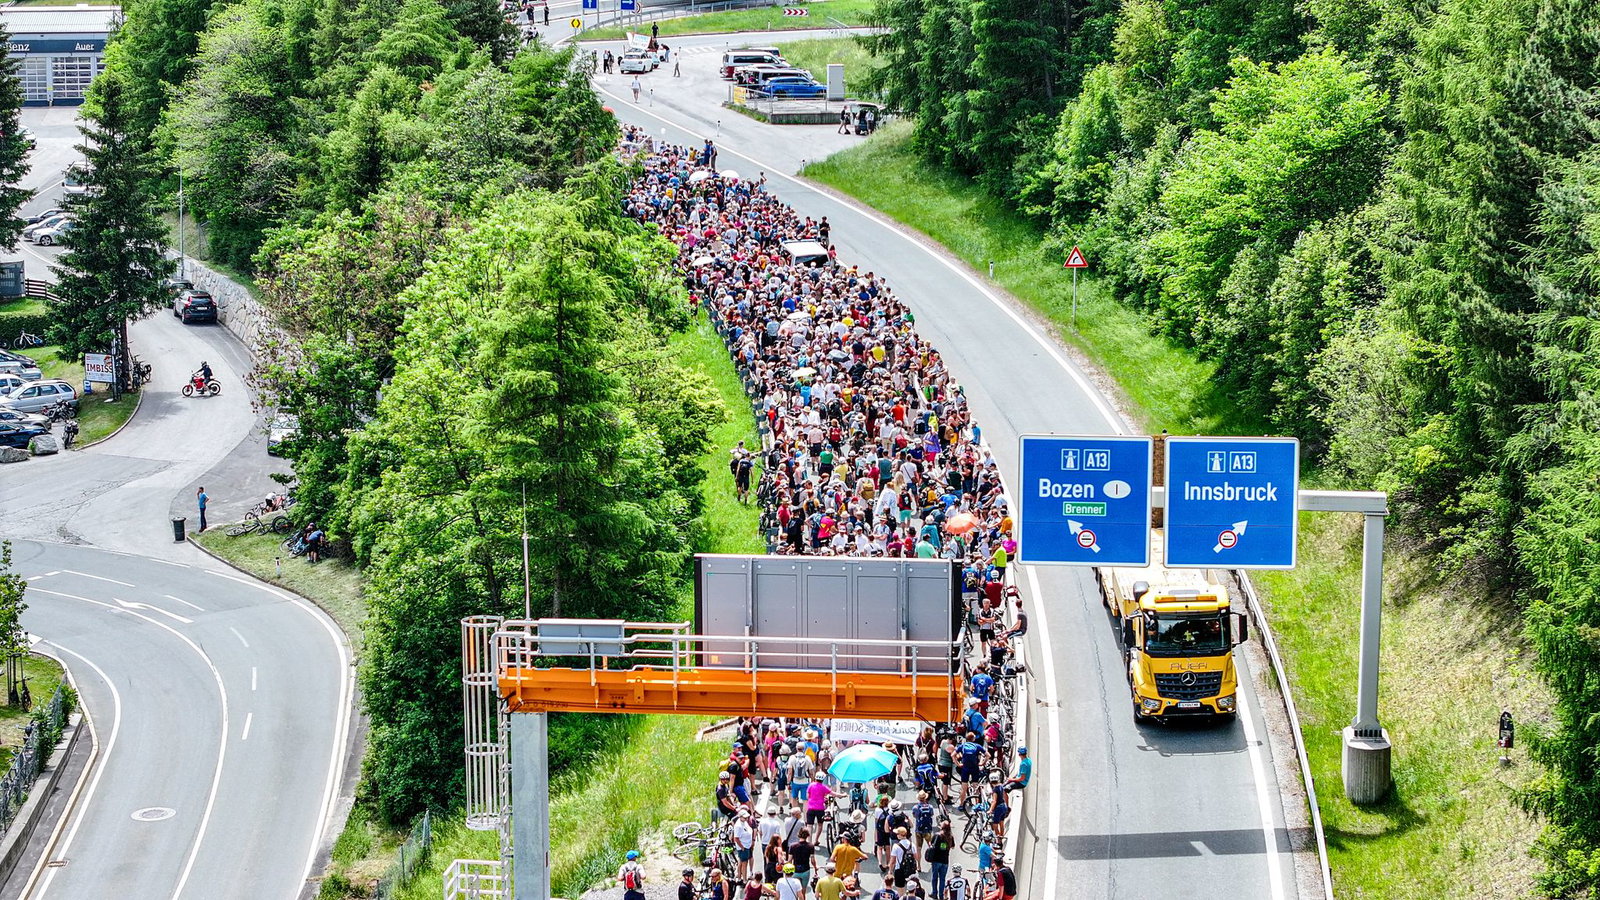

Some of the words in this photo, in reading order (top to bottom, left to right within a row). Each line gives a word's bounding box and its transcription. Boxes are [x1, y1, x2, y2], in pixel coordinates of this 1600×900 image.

[75, 42, 94, 51] Auer
[1086, 452, 1107, 468] A13
[1232, 454, 1254, 470] A13
[1039, 478, 1095, 499] Bozen
[1184, 481, 1278, 502] Innsbruck
[1065, 503, 1104, 515] Brenner
